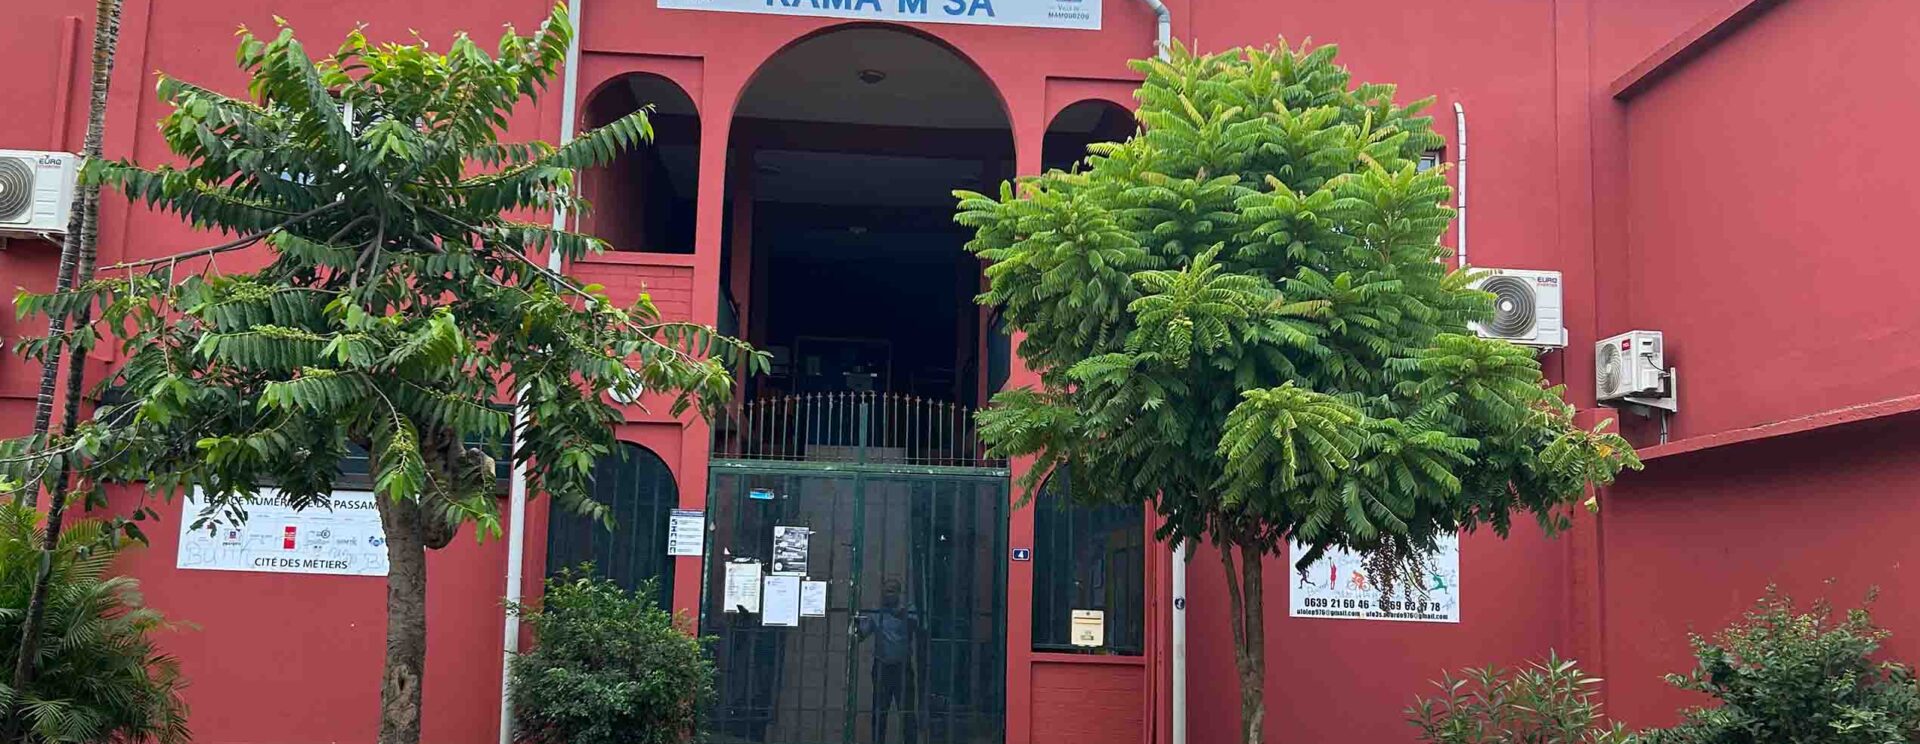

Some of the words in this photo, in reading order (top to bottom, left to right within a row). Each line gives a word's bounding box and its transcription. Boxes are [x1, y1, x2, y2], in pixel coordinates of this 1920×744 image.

[254, 557, 278, 568] CITÉ
[279, 559, 301, 568] DES
[1304, 597, 1328, 608] 0639
[1330, 598, 1341, 608] 21
[1343, 599, 1356, 609] 60
[1358, 600, 1370, 609] 46
[1378, 601, 1402, 611] 069
[1404, 601, 1416, 611] 63
[1417, 602, 1428, 612] 7
[1430, 602, 1441, 612] 78
